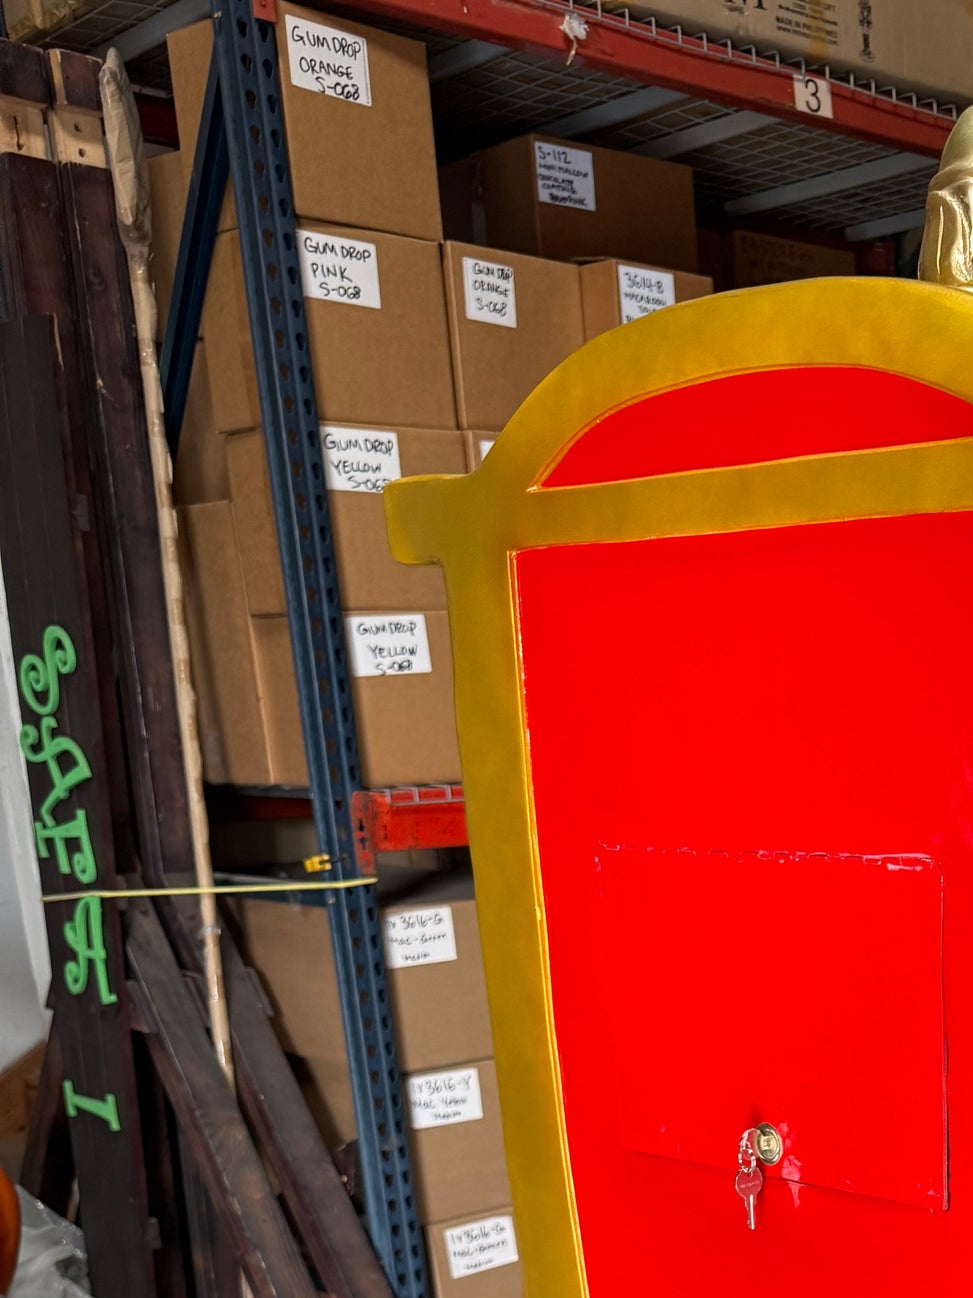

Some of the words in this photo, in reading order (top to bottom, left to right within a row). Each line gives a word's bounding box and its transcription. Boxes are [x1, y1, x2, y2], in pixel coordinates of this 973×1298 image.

[299, 56, 354, 81] ORANGE
[314, 75, 361, 101] S-068
[804, 78, 821, 113] 3
[537, 145, 571, 165] S-112
[310, 262, 354, 284] PINK
[318, 281, 362, 300] S-068
[328, 459, 382, 477] YELLOW
[366, 644, 418, 660] YELLOW
